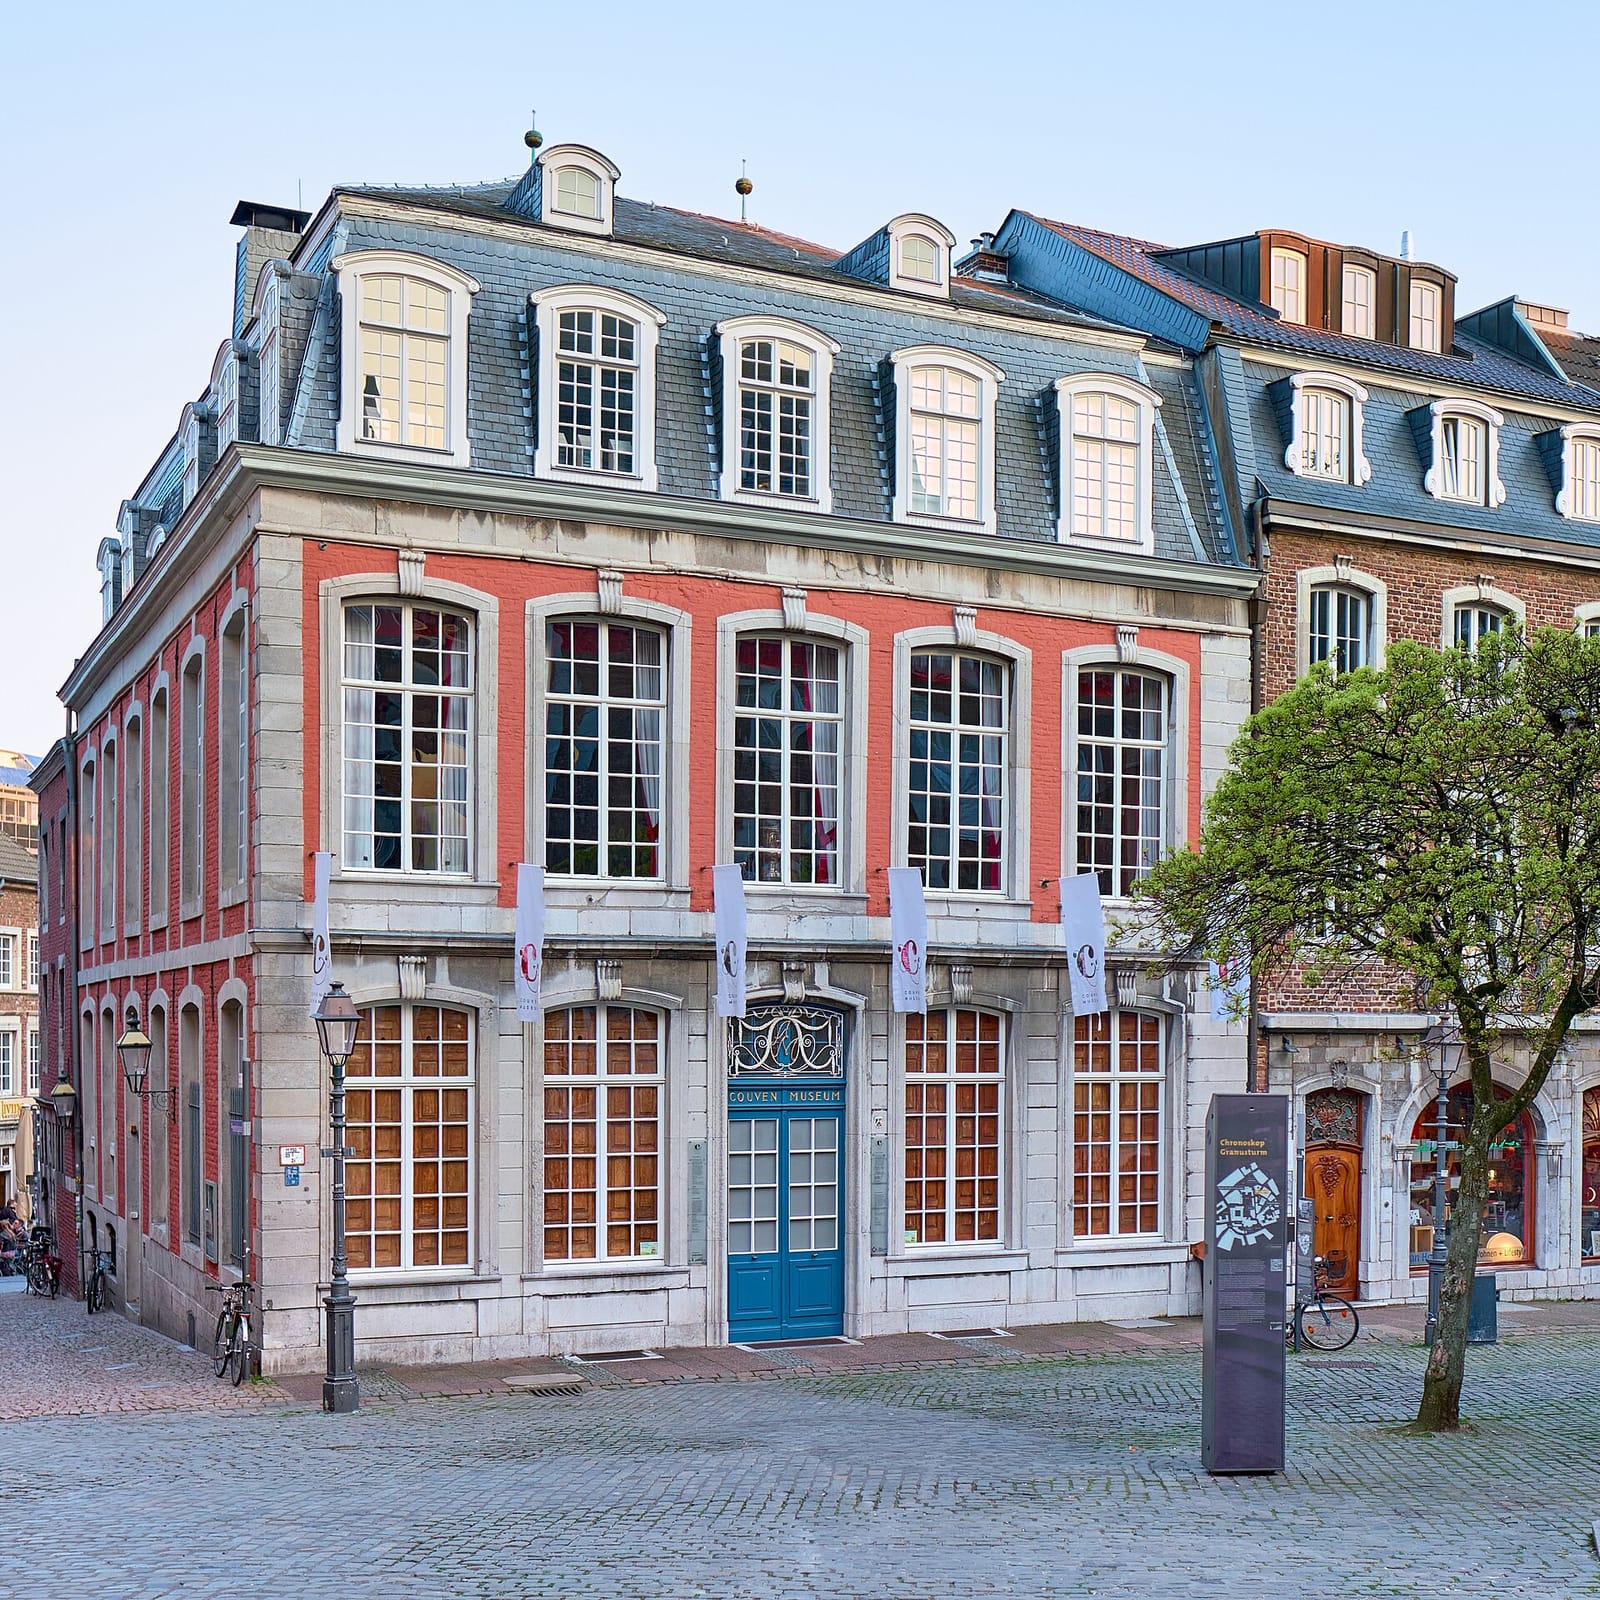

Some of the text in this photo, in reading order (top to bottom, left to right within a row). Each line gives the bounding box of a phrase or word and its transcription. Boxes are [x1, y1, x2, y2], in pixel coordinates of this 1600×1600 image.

[729, 1091, 840, 1103] COUVEN MUSEUM
[1220, 1139, 1265, 1149] Chronoskop
[1220, 1148, 1268, 1156] Granusturm
